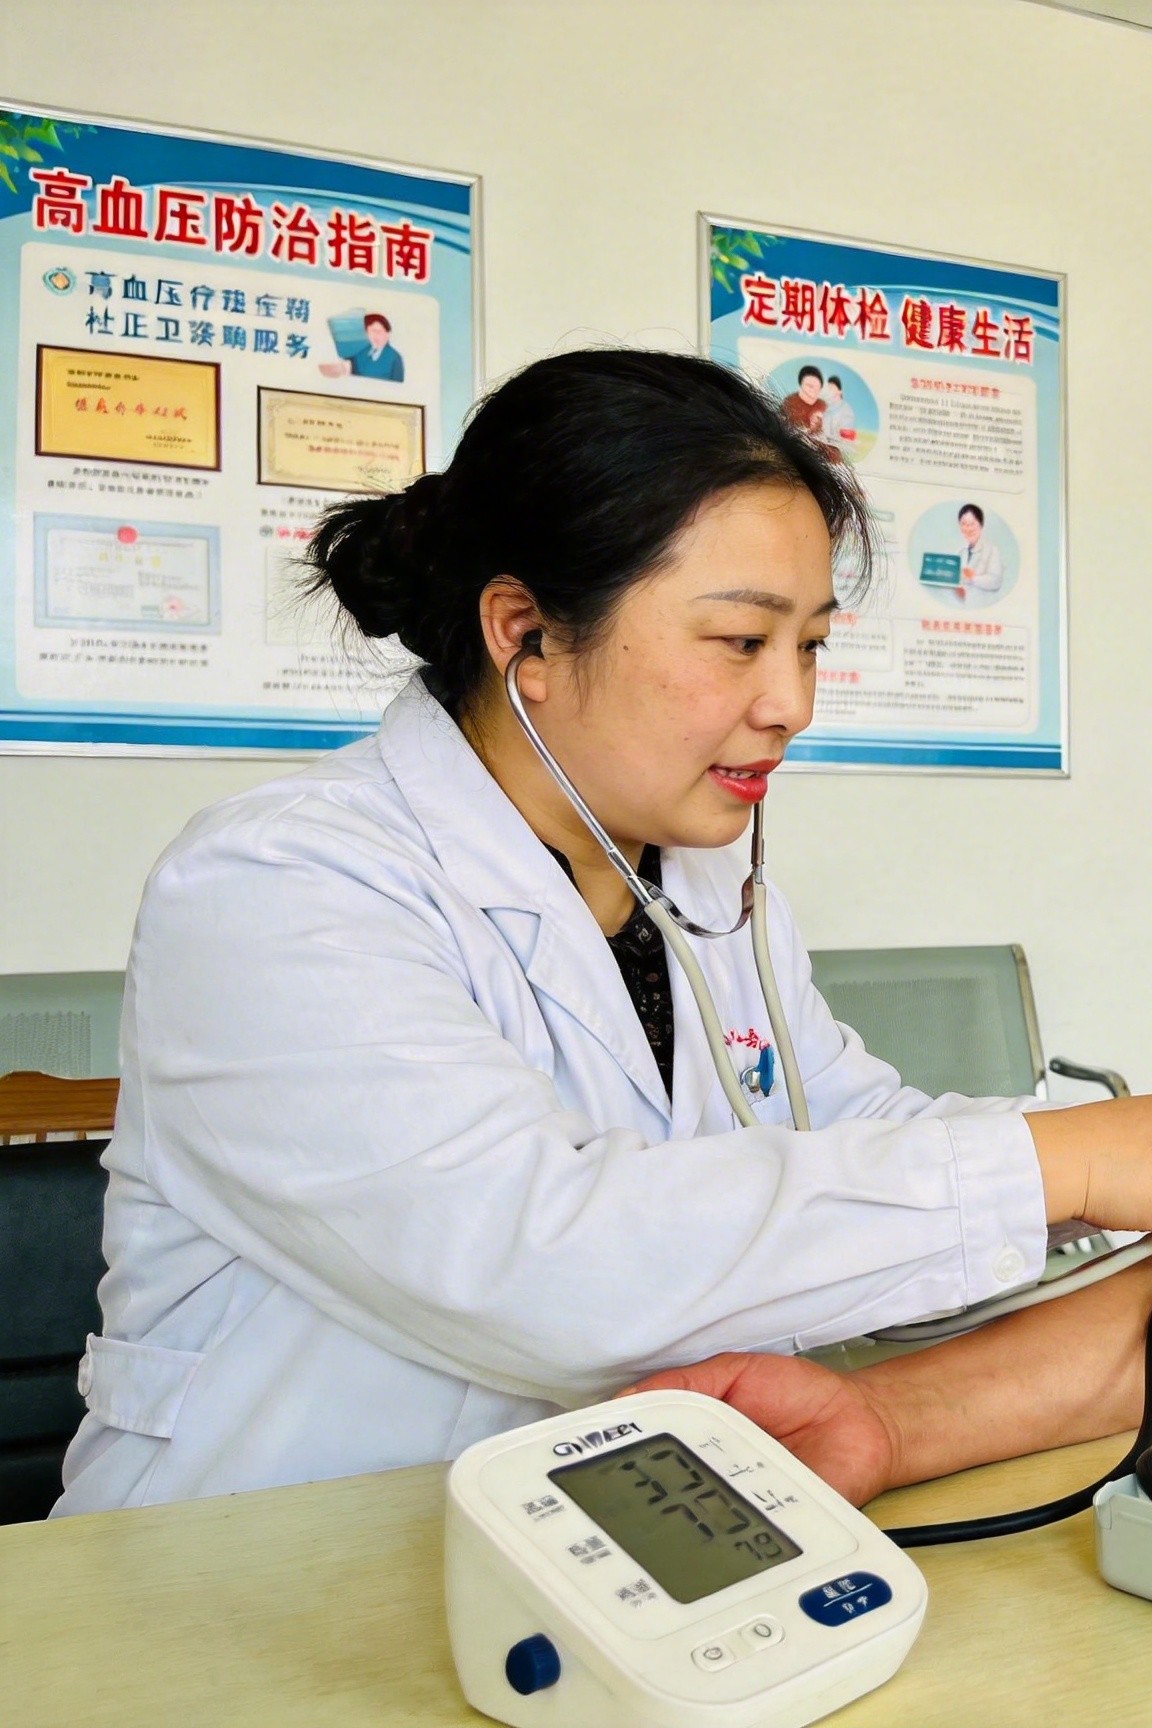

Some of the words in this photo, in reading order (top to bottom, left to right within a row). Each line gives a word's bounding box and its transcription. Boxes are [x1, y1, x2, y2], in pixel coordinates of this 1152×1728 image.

[32, 170, 433, 281] 高血压防治指南
[743, 276, 891, 340] 定期体检
[901, 297, 1033, 362] 健康生活
